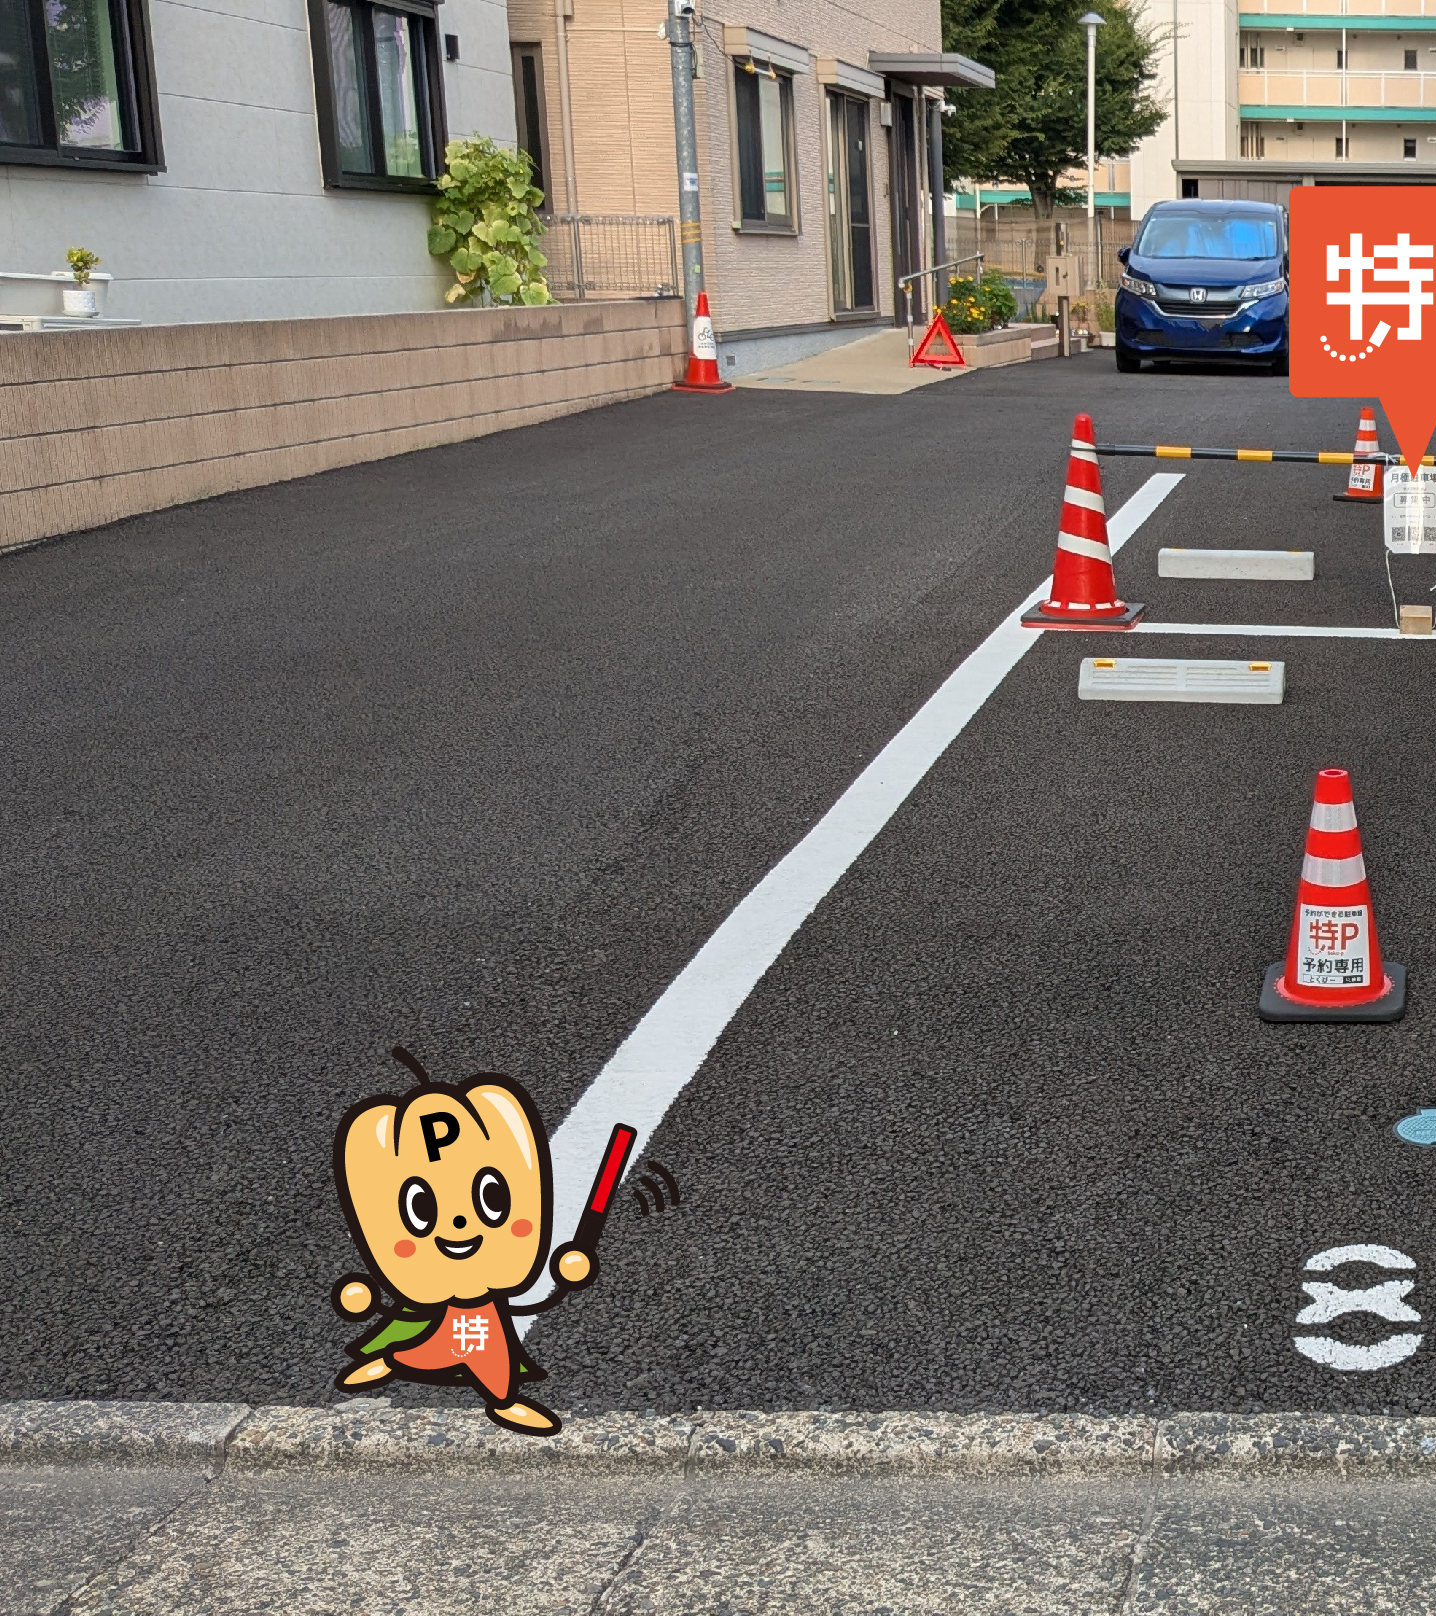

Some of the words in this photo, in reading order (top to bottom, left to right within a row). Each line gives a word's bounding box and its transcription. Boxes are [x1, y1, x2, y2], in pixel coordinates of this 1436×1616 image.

[1309, 919, 1359, 952] 特P
[1303, 957, 1363, 973] 予約専用
